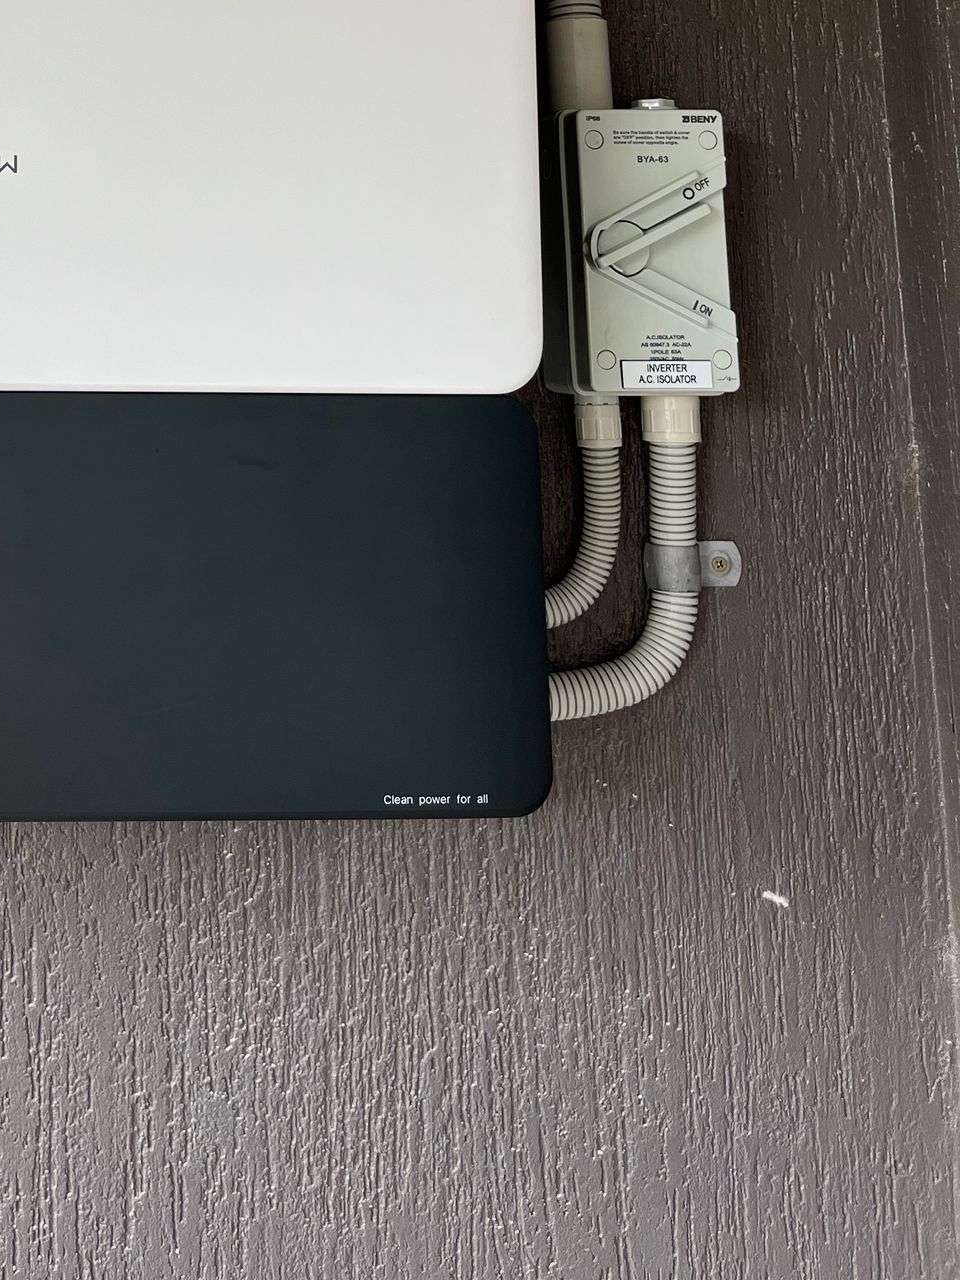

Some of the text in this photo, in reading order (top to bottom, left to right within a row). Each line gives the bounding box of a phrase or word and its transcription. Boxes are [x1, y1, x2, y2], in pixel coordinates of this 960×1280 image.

[694, 177, 710, 192] OFF
[700, 304, 713, 316] ON
[647, 364, 687, 372] INVERTER
[639, 375, 696, 383] A.C. ISOLATOR
[383, 794, 488, 806] Clean power for all
